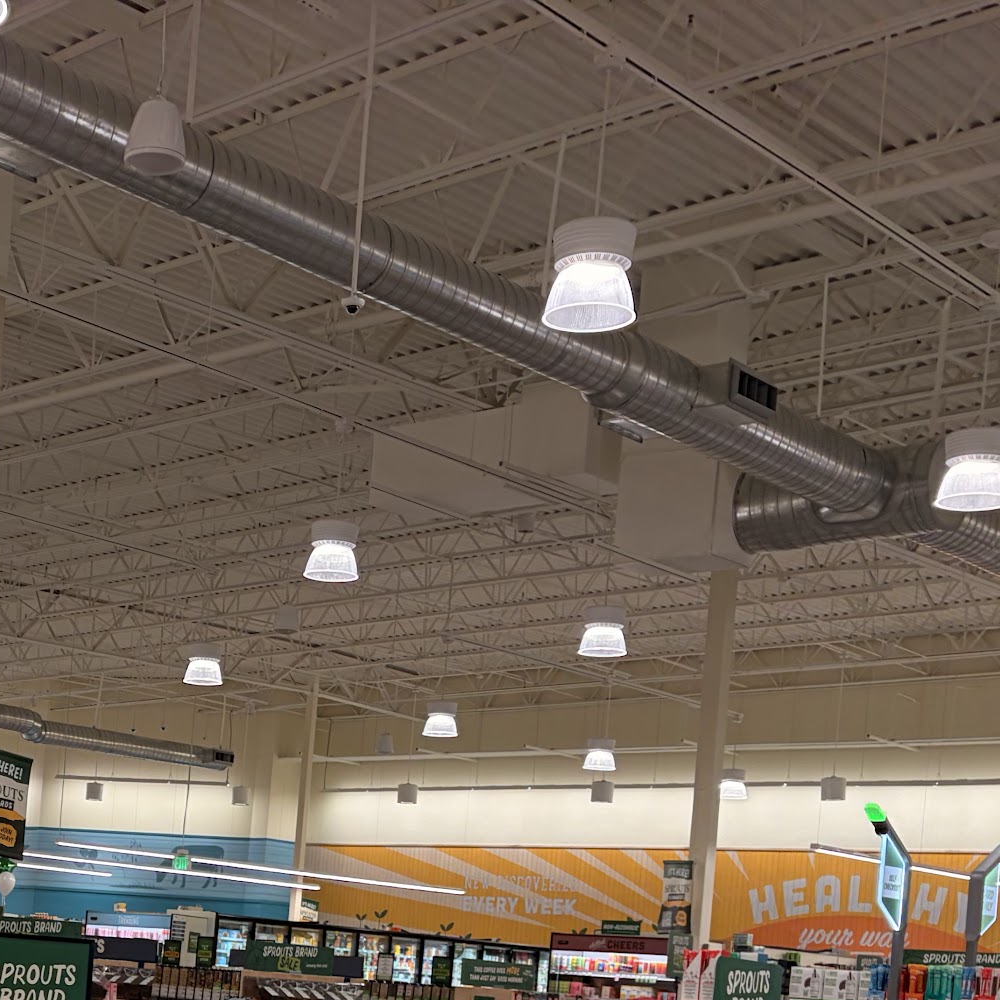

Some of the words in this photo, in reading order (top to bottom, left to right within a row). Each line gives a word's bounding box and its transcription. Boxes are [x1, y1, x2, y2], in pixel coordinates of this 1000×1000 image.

[0, 827, 12, 835] JOIN
[464, 875, 489, 889] NEW
[463, 895, 519, 912] EVERY
[524, 896, 577, 915] WEEK
[34, 922, 62, 934] BRAND
[607, 940, 646, 951] CHEERS
[798, 928, 854, 950] your
[860, 930, 911, 949] wa
[262, 946, 293, 957] SPROUTS
[294, 947, 319, 959] BRAND
[923, 953, 966, 965] SPROUTS
[280, 958, 299, 971] SALE
[727, 970, 770, 995] SPROUTS
